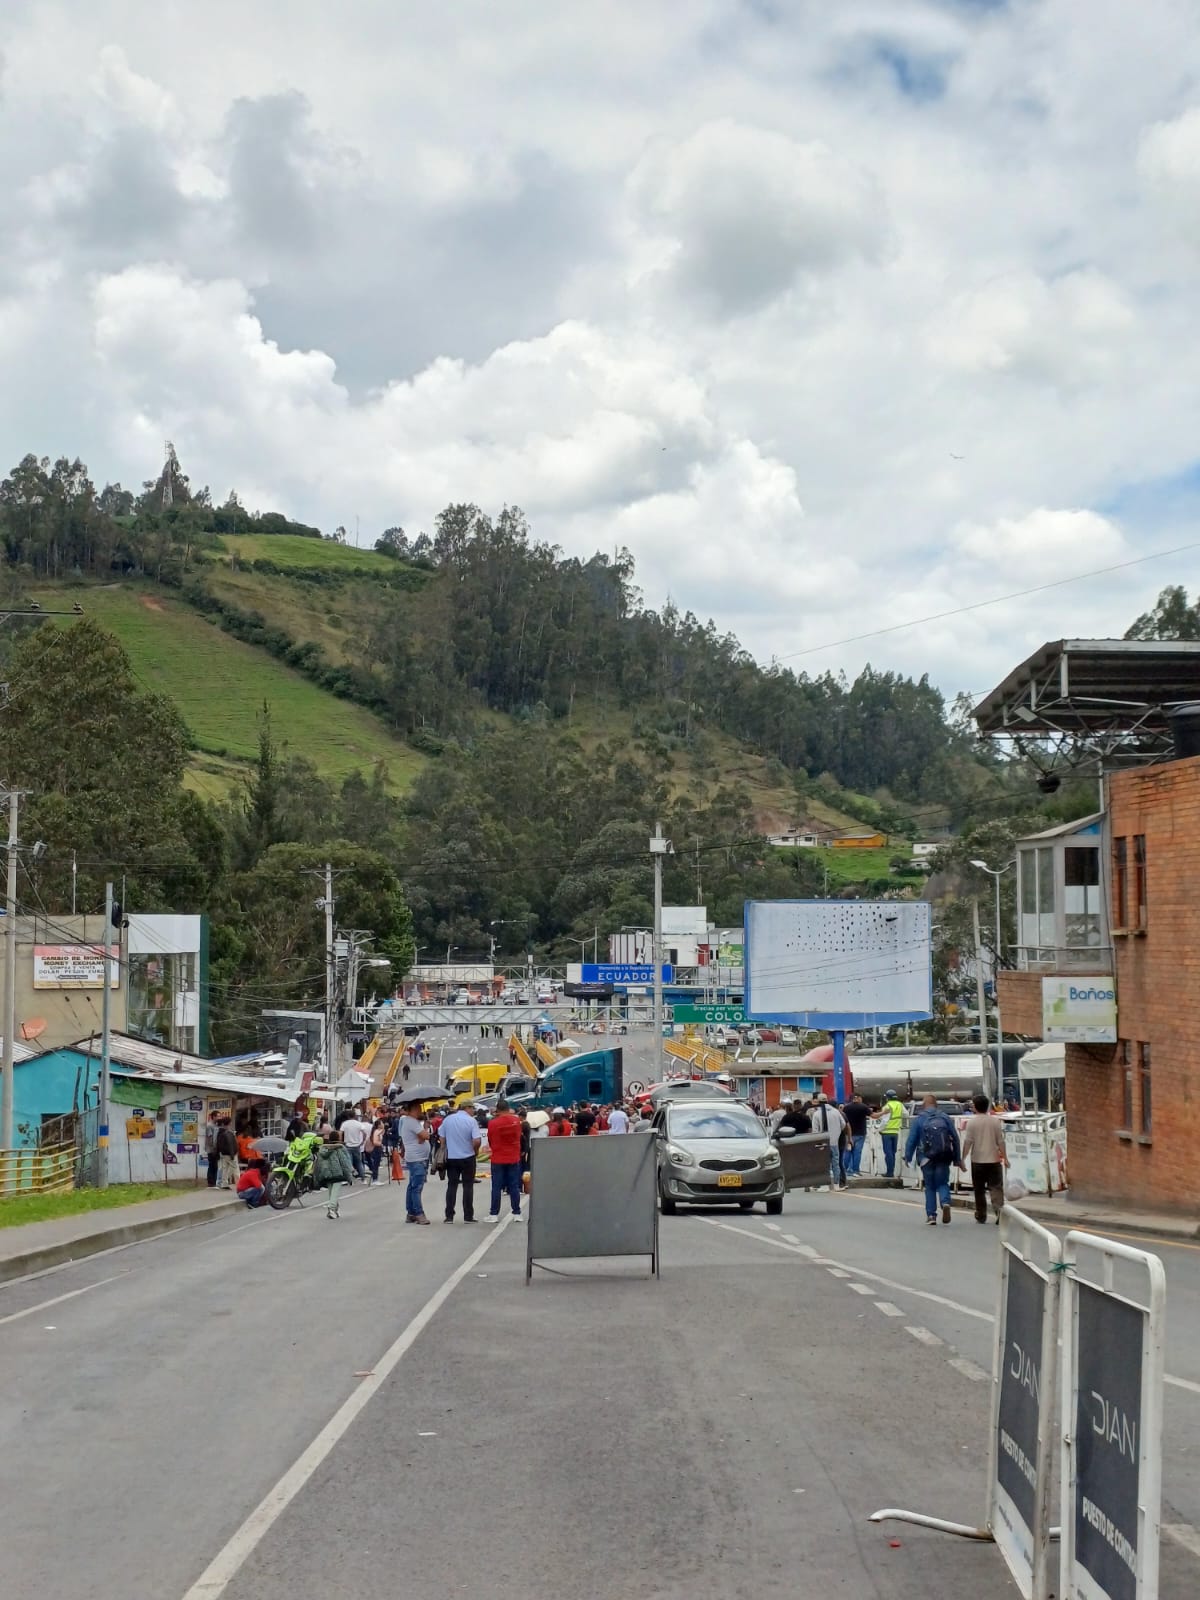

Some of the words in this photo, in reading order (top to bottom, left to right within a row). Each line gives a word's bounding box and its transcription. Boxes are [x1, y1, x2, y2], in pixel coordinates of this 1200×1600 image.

[598, 972, 655, 981] ECUADOR
[1069, 987, 1114, 1000] Baños
[705, 1011, 743, 1021] COLO
[1092, 1391, 1136, 1464] DIAN
[1082, 1496, 1106, 1537] PUESTO
[1106, 1518, 1115, 1547] DE
